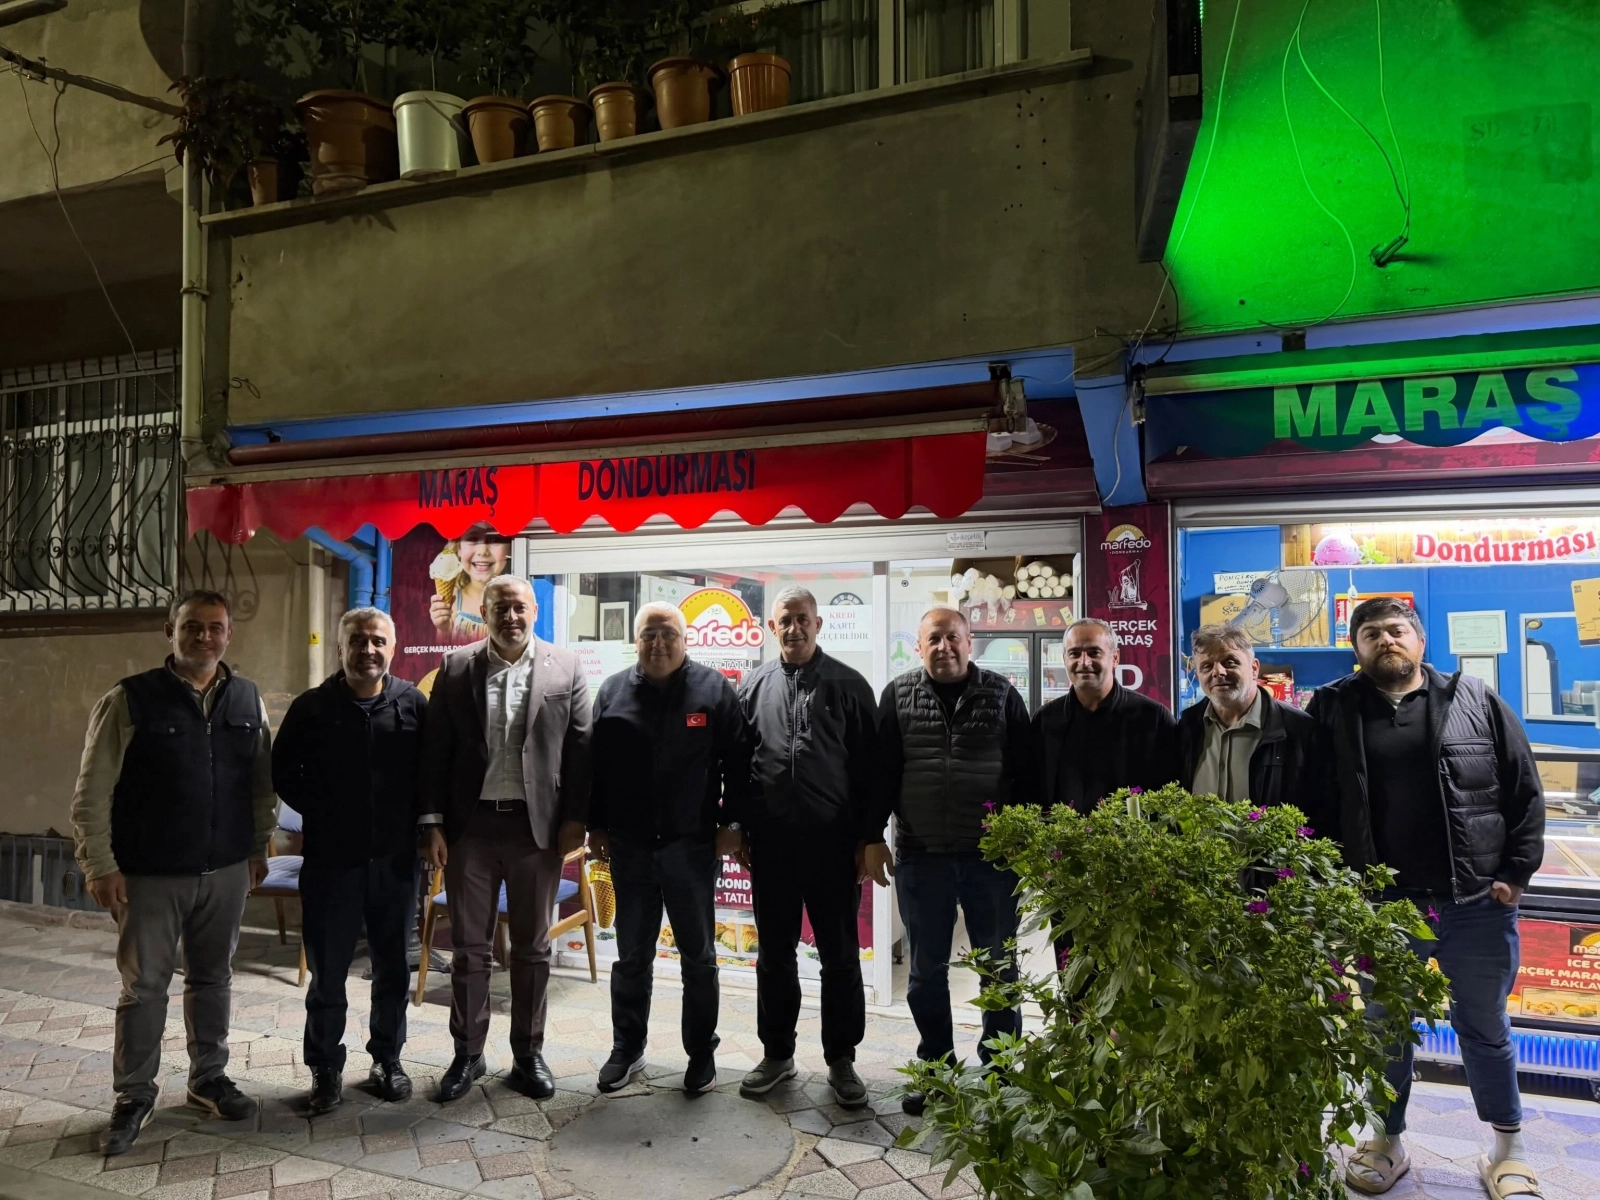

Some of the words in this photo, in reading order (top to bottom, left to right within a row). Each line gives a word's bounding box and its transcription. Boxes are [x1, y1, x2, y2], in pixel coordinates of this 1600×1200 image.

[1273, 366, 1582, 438] MARAŞ
[418, 466, 499, 517] MARAŞ
[578, 450, 756, 501] DONDURMASI
[1100, 537, 1152, 550] marfedo
[1415, 530, 1597, 563] Dondurması
[829, 611, 856, 619] KREDİ
[829, 622, 856, 630] KARTI
[1107, 619, 1158, 634] ERÇEK
[686, 618, 764, 648] arfedo
[1117, 634, 1154, 648] ARAŞ
[404, 646, 429, 655] GERÇEK
[1567, 959, 1591, 969] ICE
[1517, 966, 1555, 977] RÇEK
